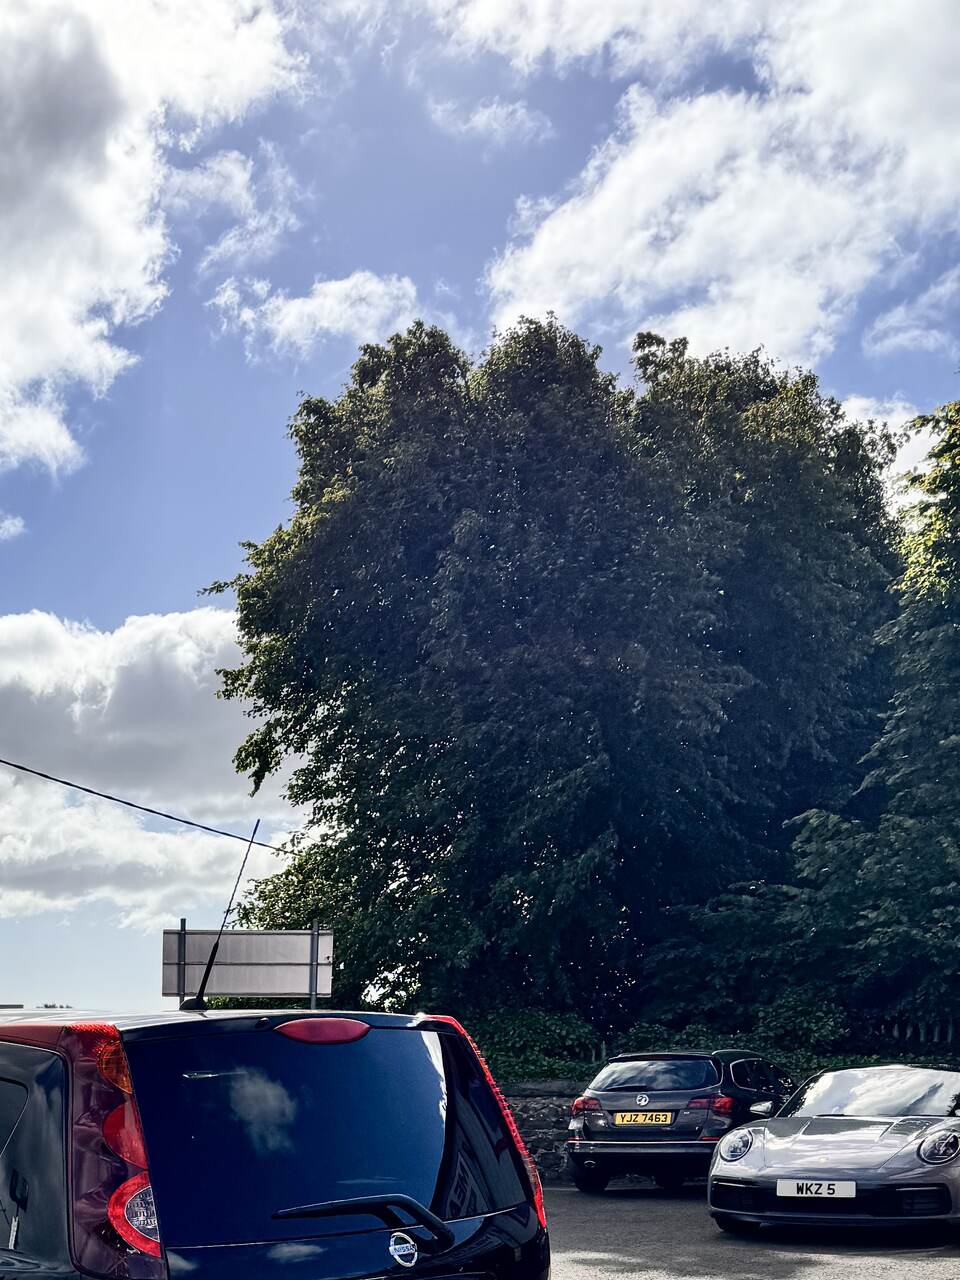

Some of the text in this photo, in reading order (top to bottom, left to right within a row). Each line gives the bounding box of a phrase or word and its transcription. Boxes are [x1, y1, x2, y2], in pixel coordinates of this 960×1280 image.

[620, 1114, 668, 1123] YJZ 7463
[796, 1183, 836, 1195] WKZ 5
